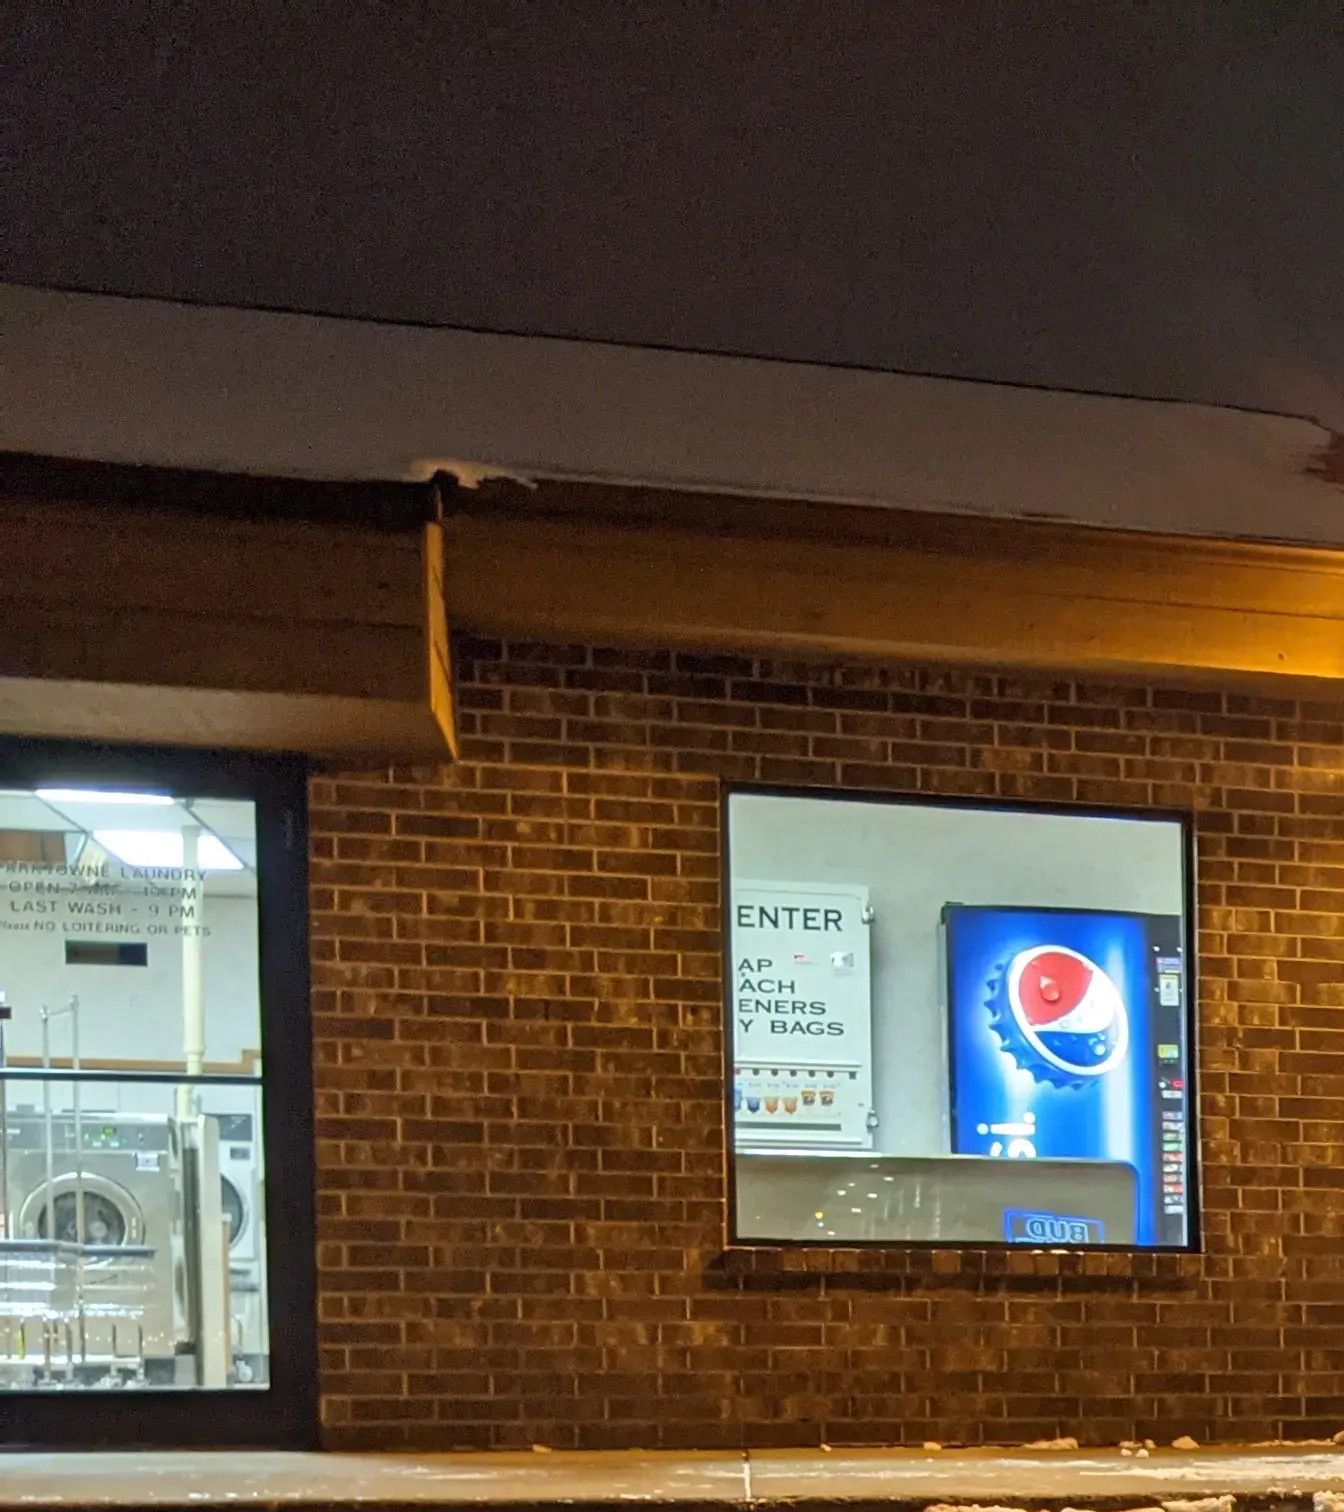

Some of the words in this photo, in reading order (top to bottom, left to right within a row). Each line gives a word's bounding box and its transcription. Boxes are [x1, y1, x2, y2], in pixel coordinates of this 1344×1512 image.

[120, 866, 206, 881] LAUNDRY
[9, 881, 60, 895] OPEN
[170, 887, 197, 900] PM
[10, 900, 58, 913] LAST
[68, 902, 121, 915] WASH
[149, 905, 159, 917] 9
[168, 905, 195, 918] PM
[737, 904, 843, 932] ENTER
[33, 920, 56, 932] NO
[63, 921, 140, 935] LOITERING
[147, 924, 168, 935] OR
[174, 926, 211, 937] PETS
[738, 957, 773, 973] AP
[739, 978, 796, 994] ACH
[738, 998, 827, 1016] ENERS
[739, 1018, 754, 1033] Y
[770, 1020, 845, 1036] BAGS
